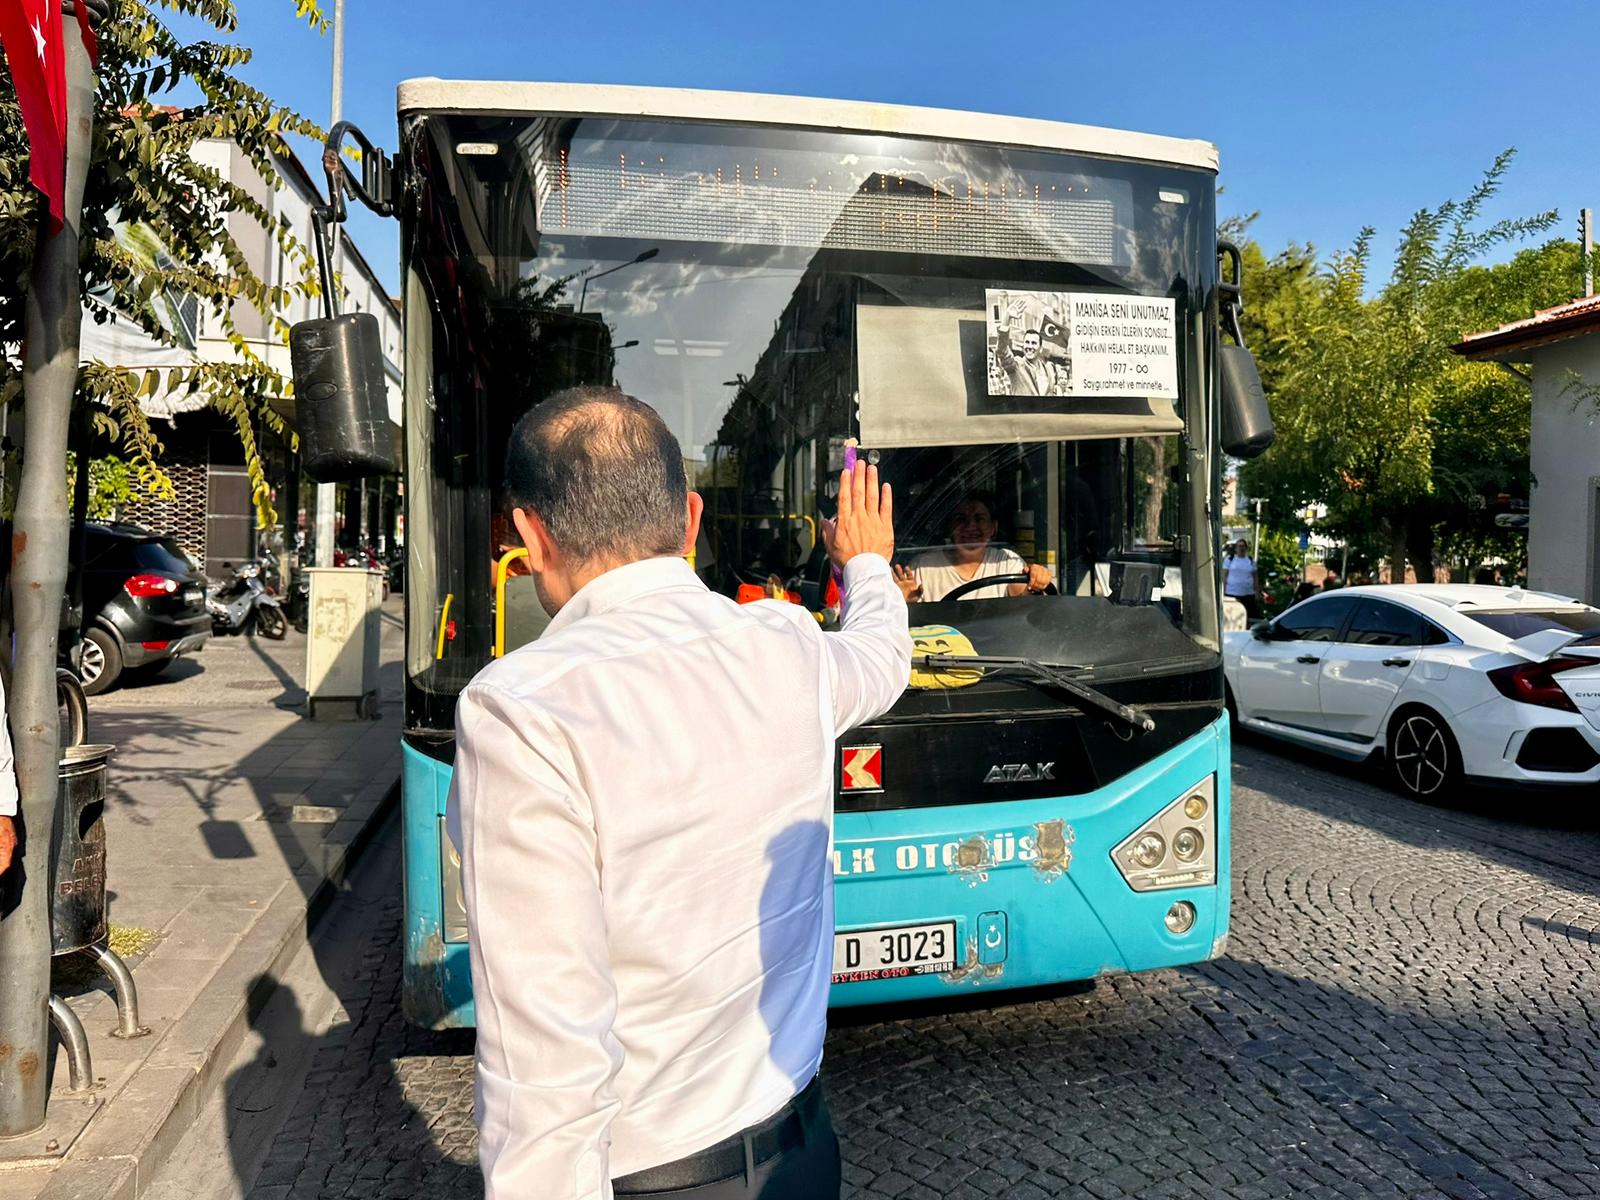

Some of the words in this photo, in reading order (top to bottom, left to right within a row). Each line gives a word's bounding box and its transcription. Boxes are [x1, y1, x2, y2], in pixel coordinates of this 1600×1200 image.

[1075, 299, 1109, 319] MANİSA
[1111, 300, 1129, 319] SENİ
[1131, 304, 1171, 323] UNUTMAZ,
[1101, 325, 1120, 337] ERKEN
[1108, 343, 1126, 355] HELAL
[1128, 344, 1134, 355] ET
[1109, 363, 1127, 374] 1977
[983, 762, 1056, 783] ATAK
[846, 938, 861, 968] D
[880, 929, 945, 964] 3023
